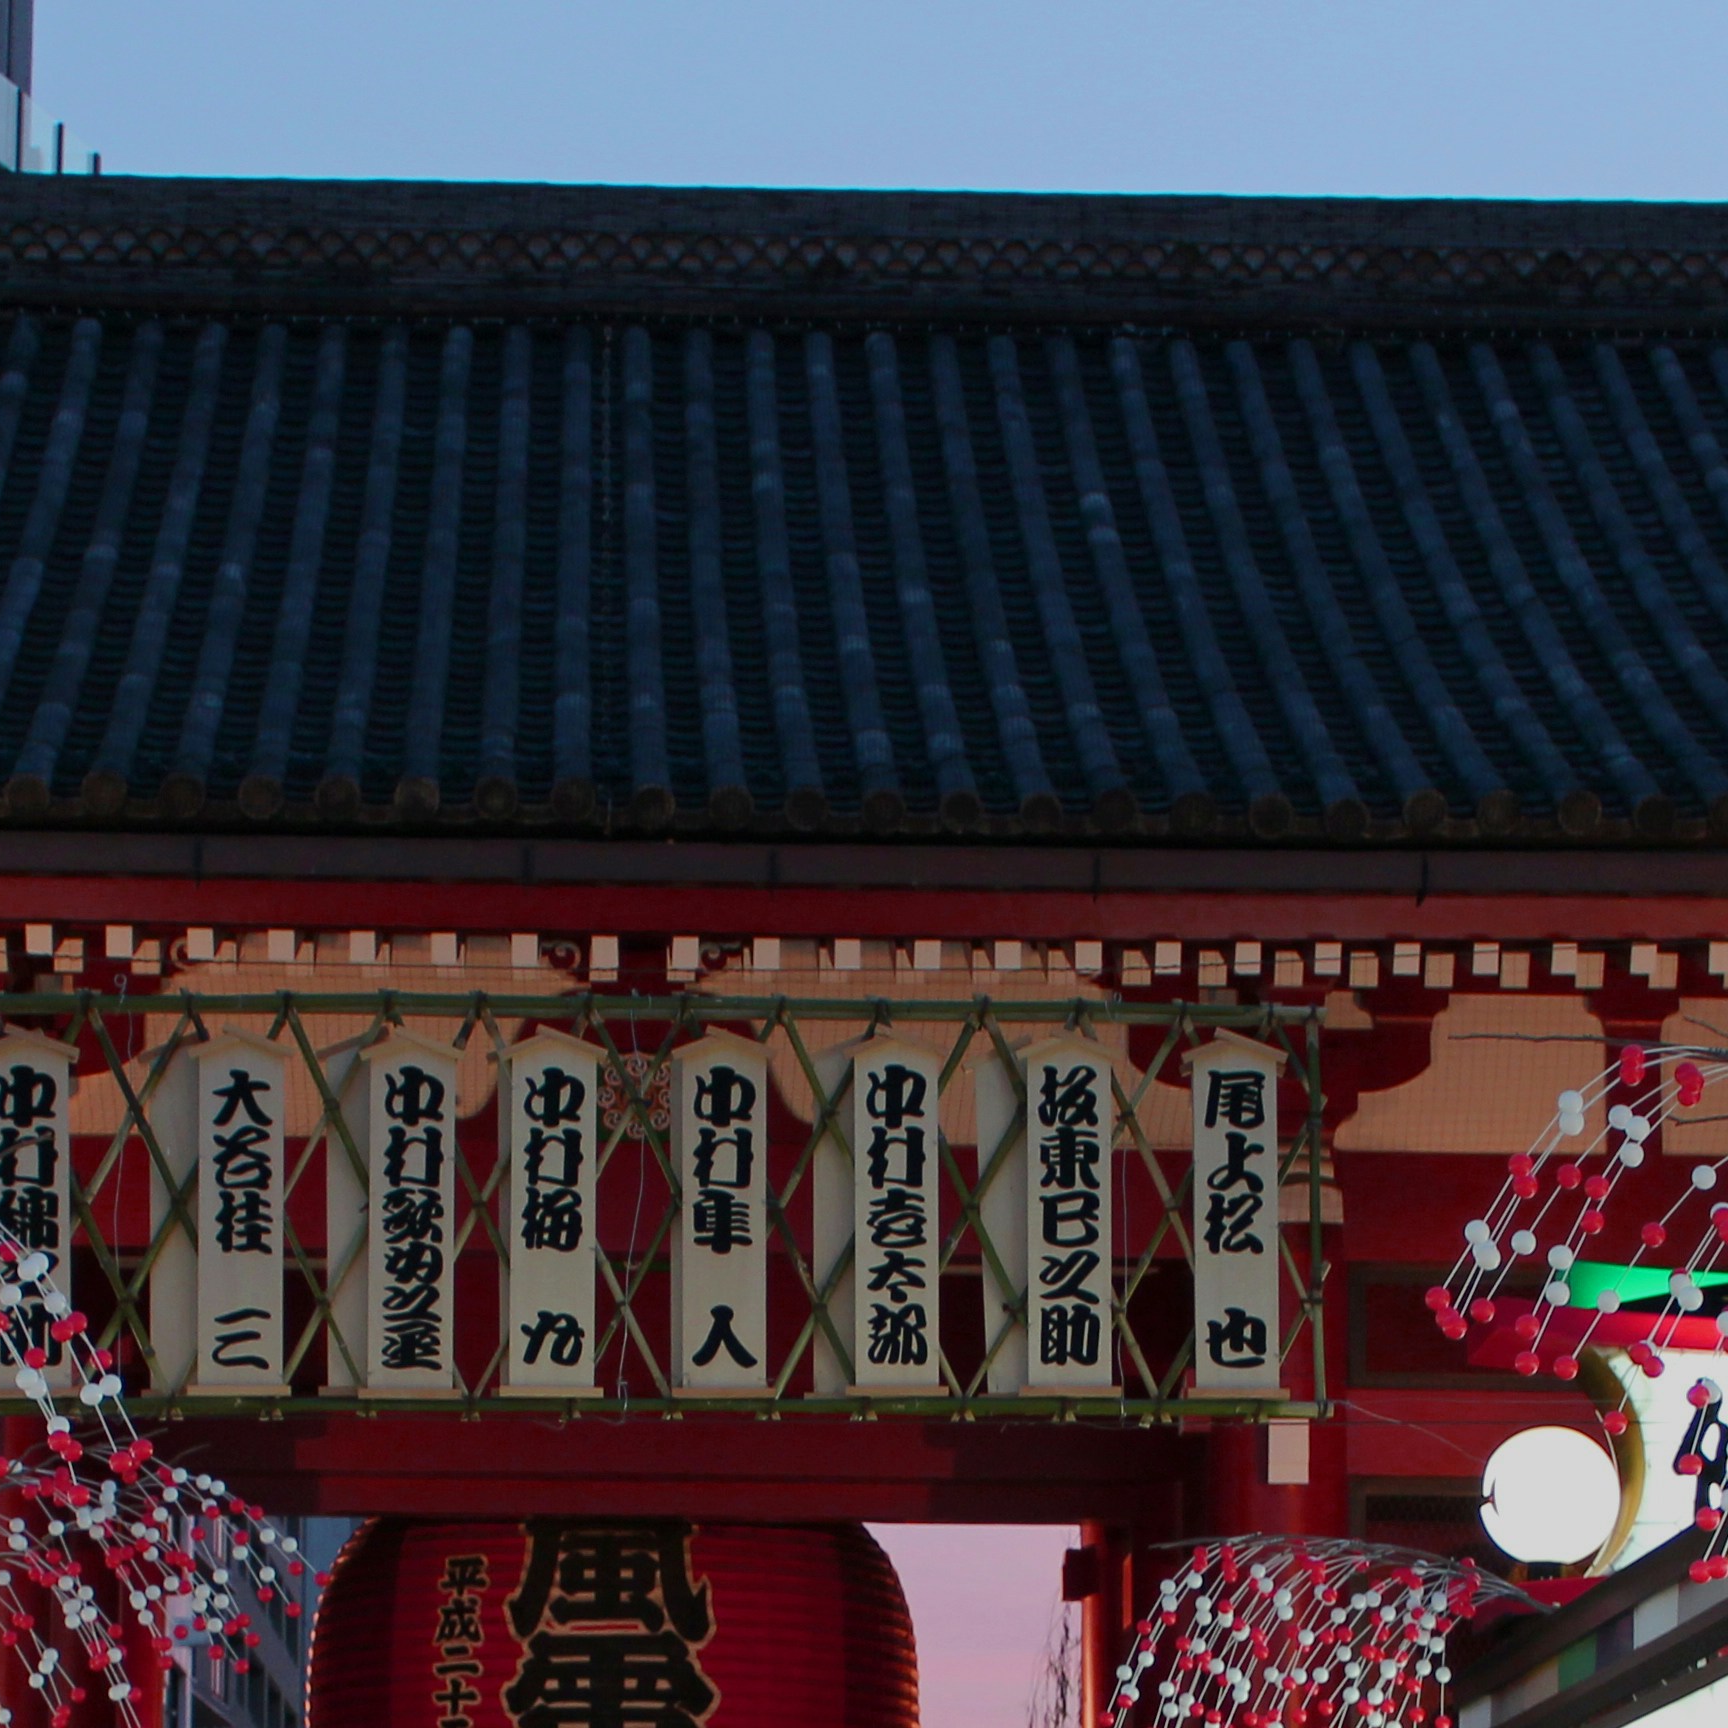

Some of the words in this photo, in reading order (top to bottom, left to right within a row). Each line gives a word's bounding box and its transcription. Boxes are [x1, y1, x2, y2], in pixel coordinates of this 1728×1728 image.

[213, 1070, 273, 1369] 大谷桂三
[521, 1067, 585, 1366] 中村梅丸
[692, 1065, 758, 1369] 中村隼人
[1038, 1065, 1101, 1366] 坂東巳之助
[1204, 1069, 1268, 1368] 尾上松也
